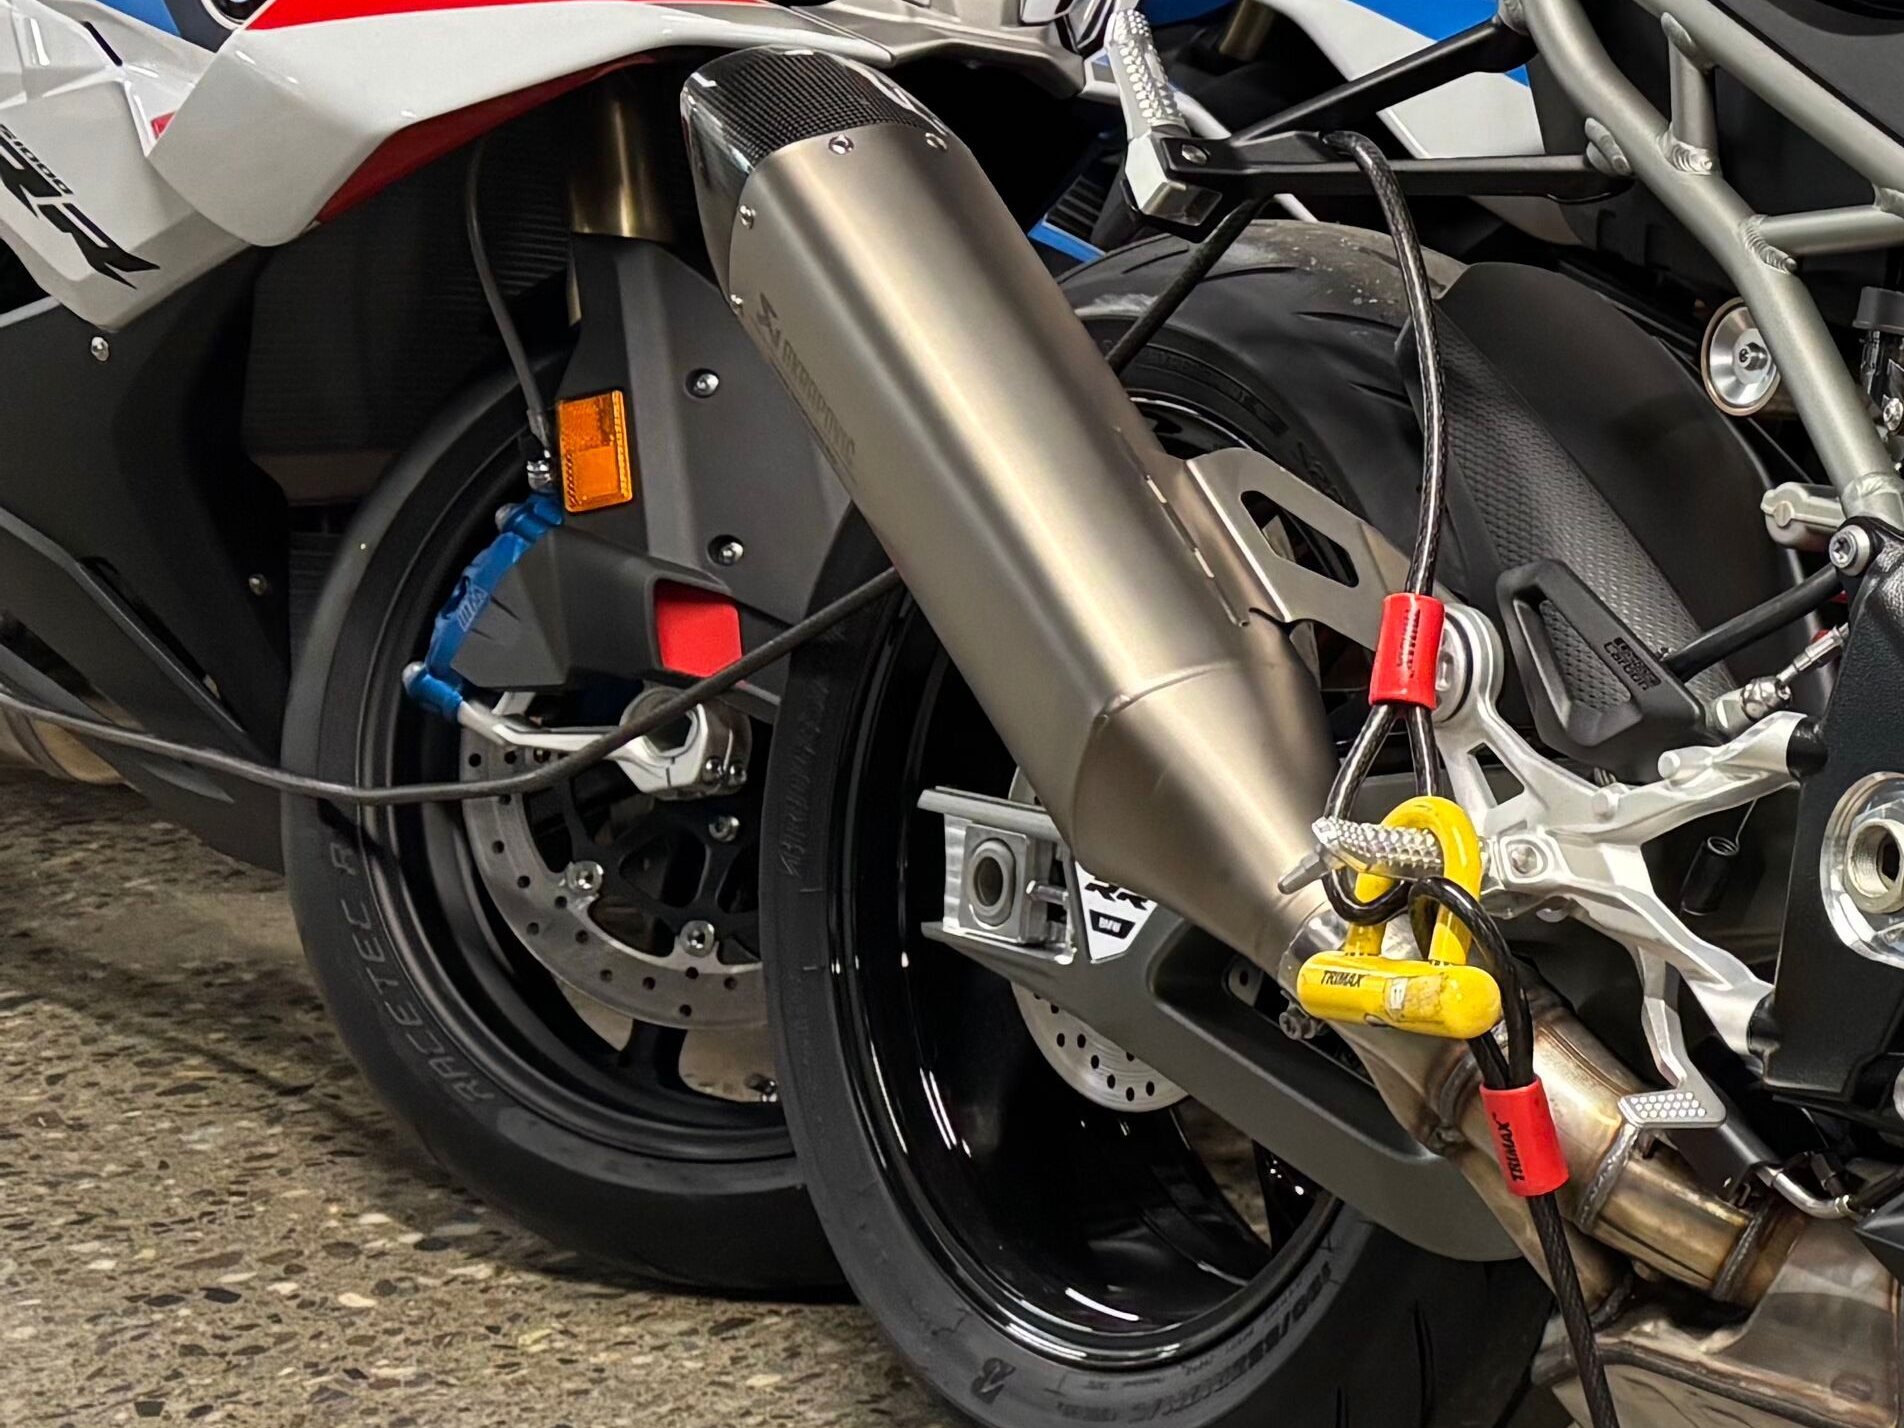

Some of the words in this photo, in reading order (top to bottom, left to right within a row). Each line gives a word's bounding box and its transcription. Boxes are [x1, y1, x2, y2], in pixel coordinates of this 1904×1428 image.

[341, 898, 495, 1103] RACETEC
[1320, 970, 1363, 988] TRIMAX
[1497, 1119, 1526, 1182] TRIMAX
